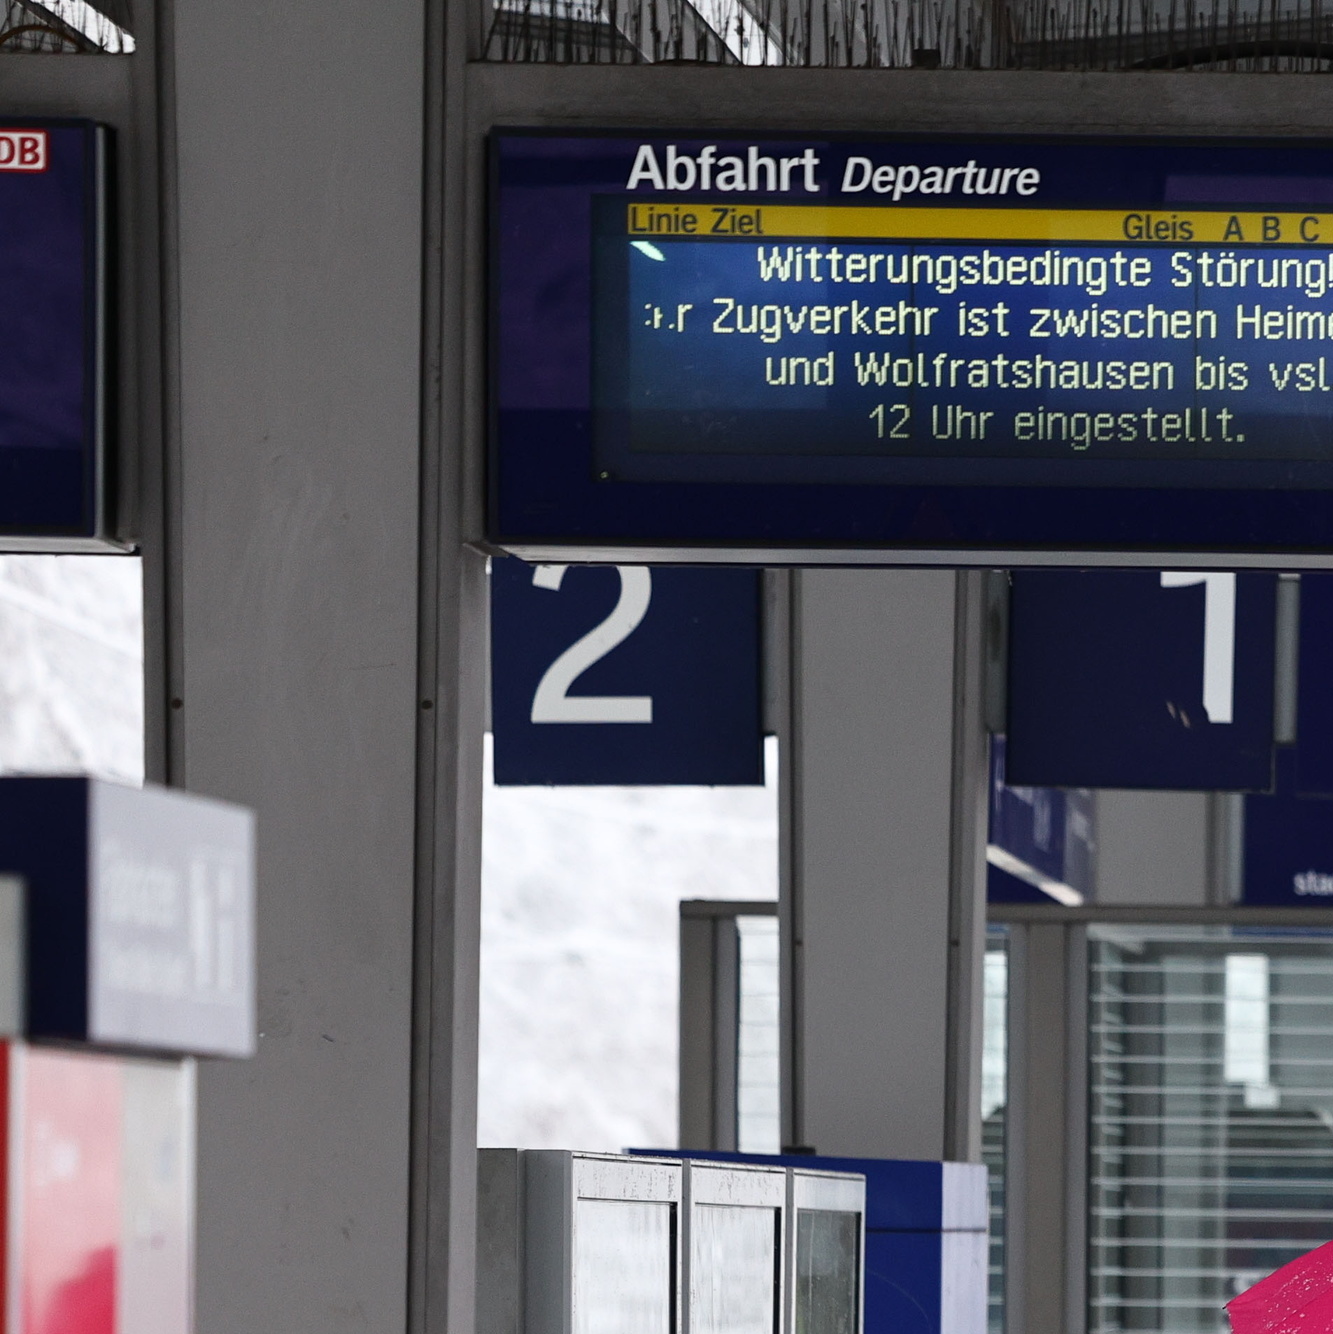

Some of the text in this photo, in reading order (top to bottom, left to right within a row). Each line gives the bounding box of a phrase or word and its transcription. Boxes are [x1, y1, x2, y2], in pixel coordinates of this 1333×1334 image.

[626, 144, 1041, 201] Abfahrt Departure
[629, 207, 764, 236] Linie Ziel
[1122, 213, 1194, 242] Gleis
[1222, 215, 1244, 242] A
[1261, 216, 1282, 243] B
[1299, 216, 1319, 243] C
[757, 246, 1152, 295] Witterungsbedingte
[712, 298, 938, 342] Zugverkehr
[958, 301, 1010, 337] ist
[1030, 303, 1217, 340] zwischen
[765, 351, 835, 386] und
[854, 351, 1175, 390] Wolfratshausen
[1195, 355, 1249, 391] bis
[869, 403, 1246, 450] 12 Uhr eingestellt.
[530, 565, 653, 724] 2
[1160, 571, 1236, 724] 1
